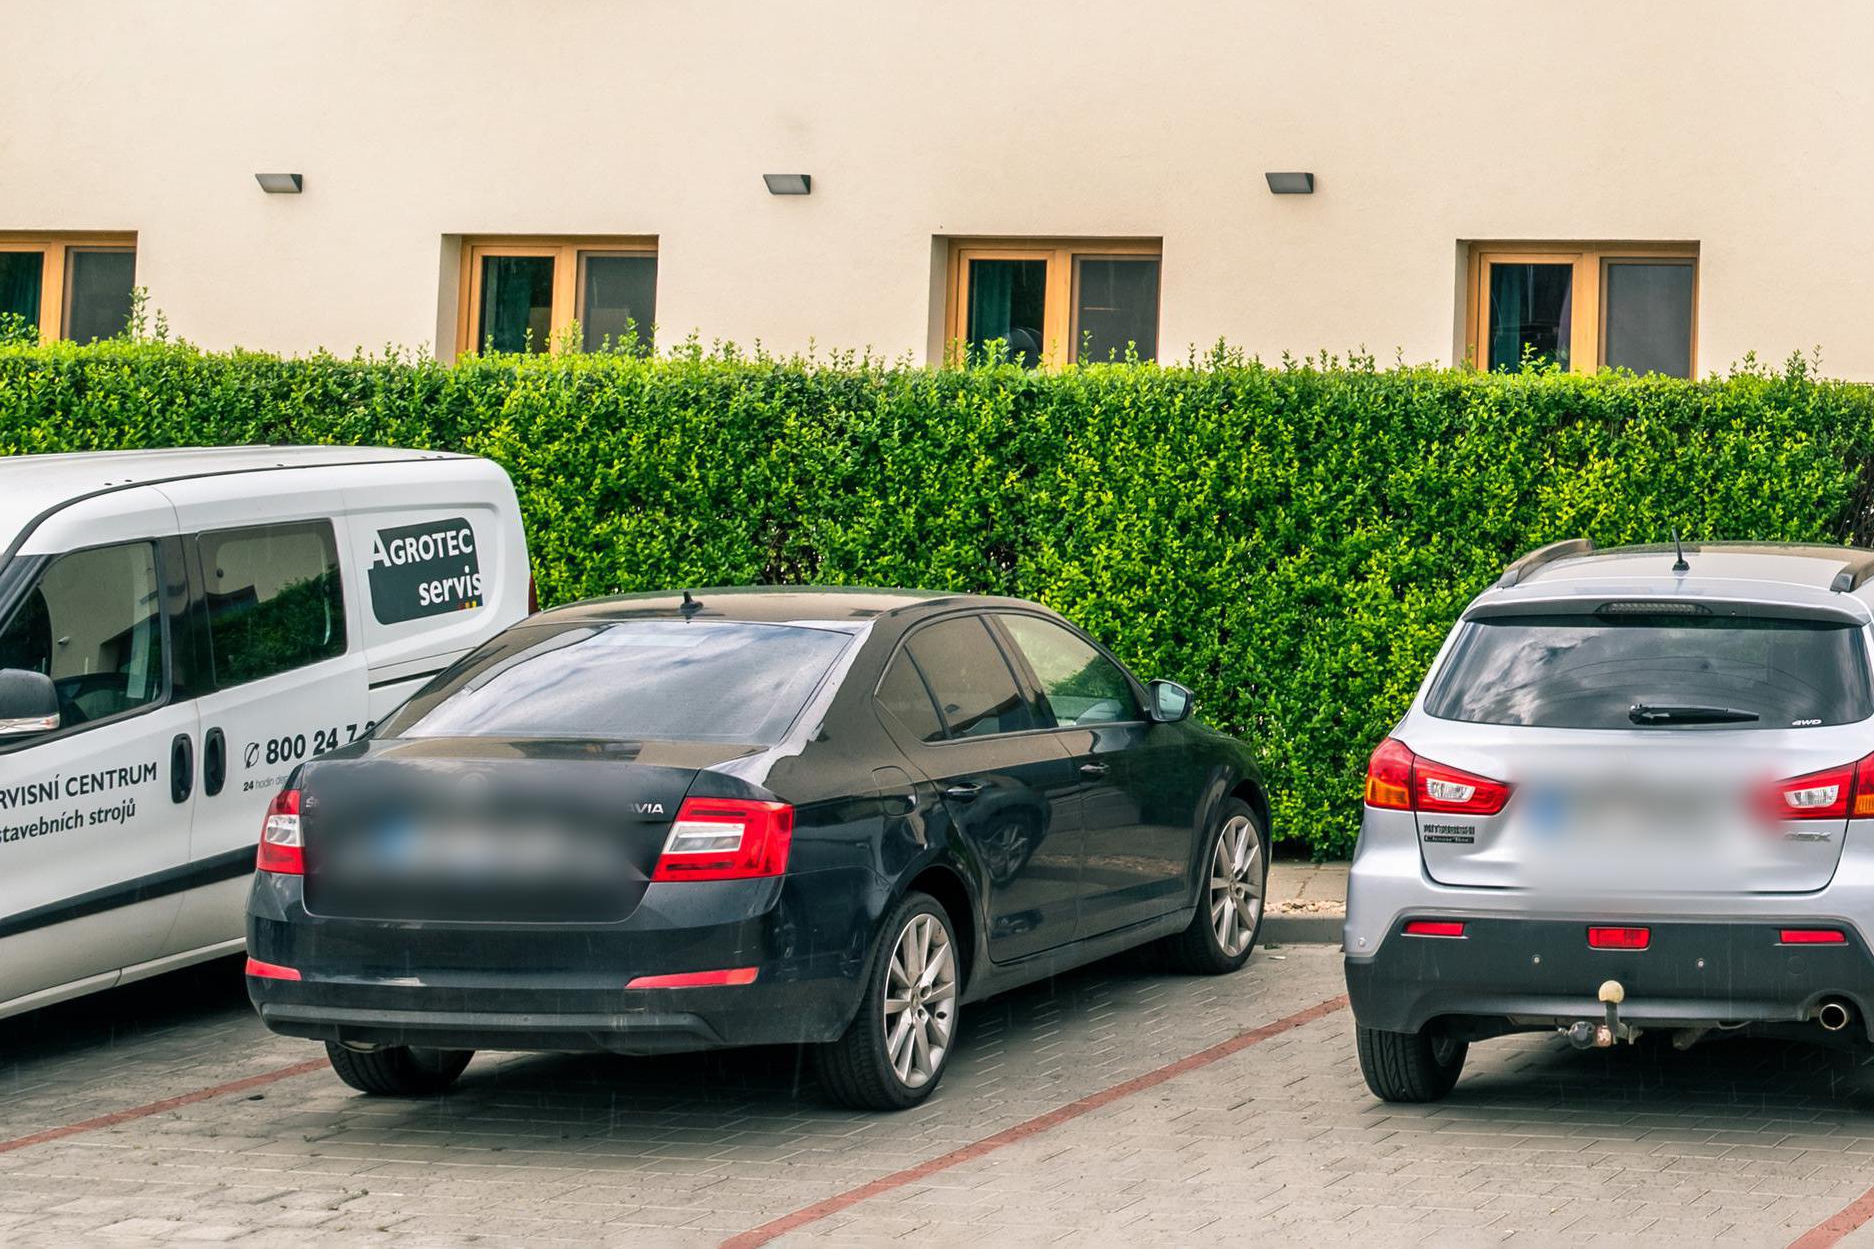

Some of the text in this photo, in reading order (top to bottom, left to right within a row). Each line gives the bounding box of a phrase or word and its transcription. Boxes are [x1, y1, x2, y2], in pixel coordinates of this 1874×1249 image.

[373, 528, 474, 567] AGROTEC
[418, 565, 482, 606] servis
[265, 734, 306, 764] 800
[313, 727, 339, 755] 24
[65, 762, 157, 797] CENTRUM
[243, 780, 254, 792] 24
[89, 798, 136, 825] strojů
